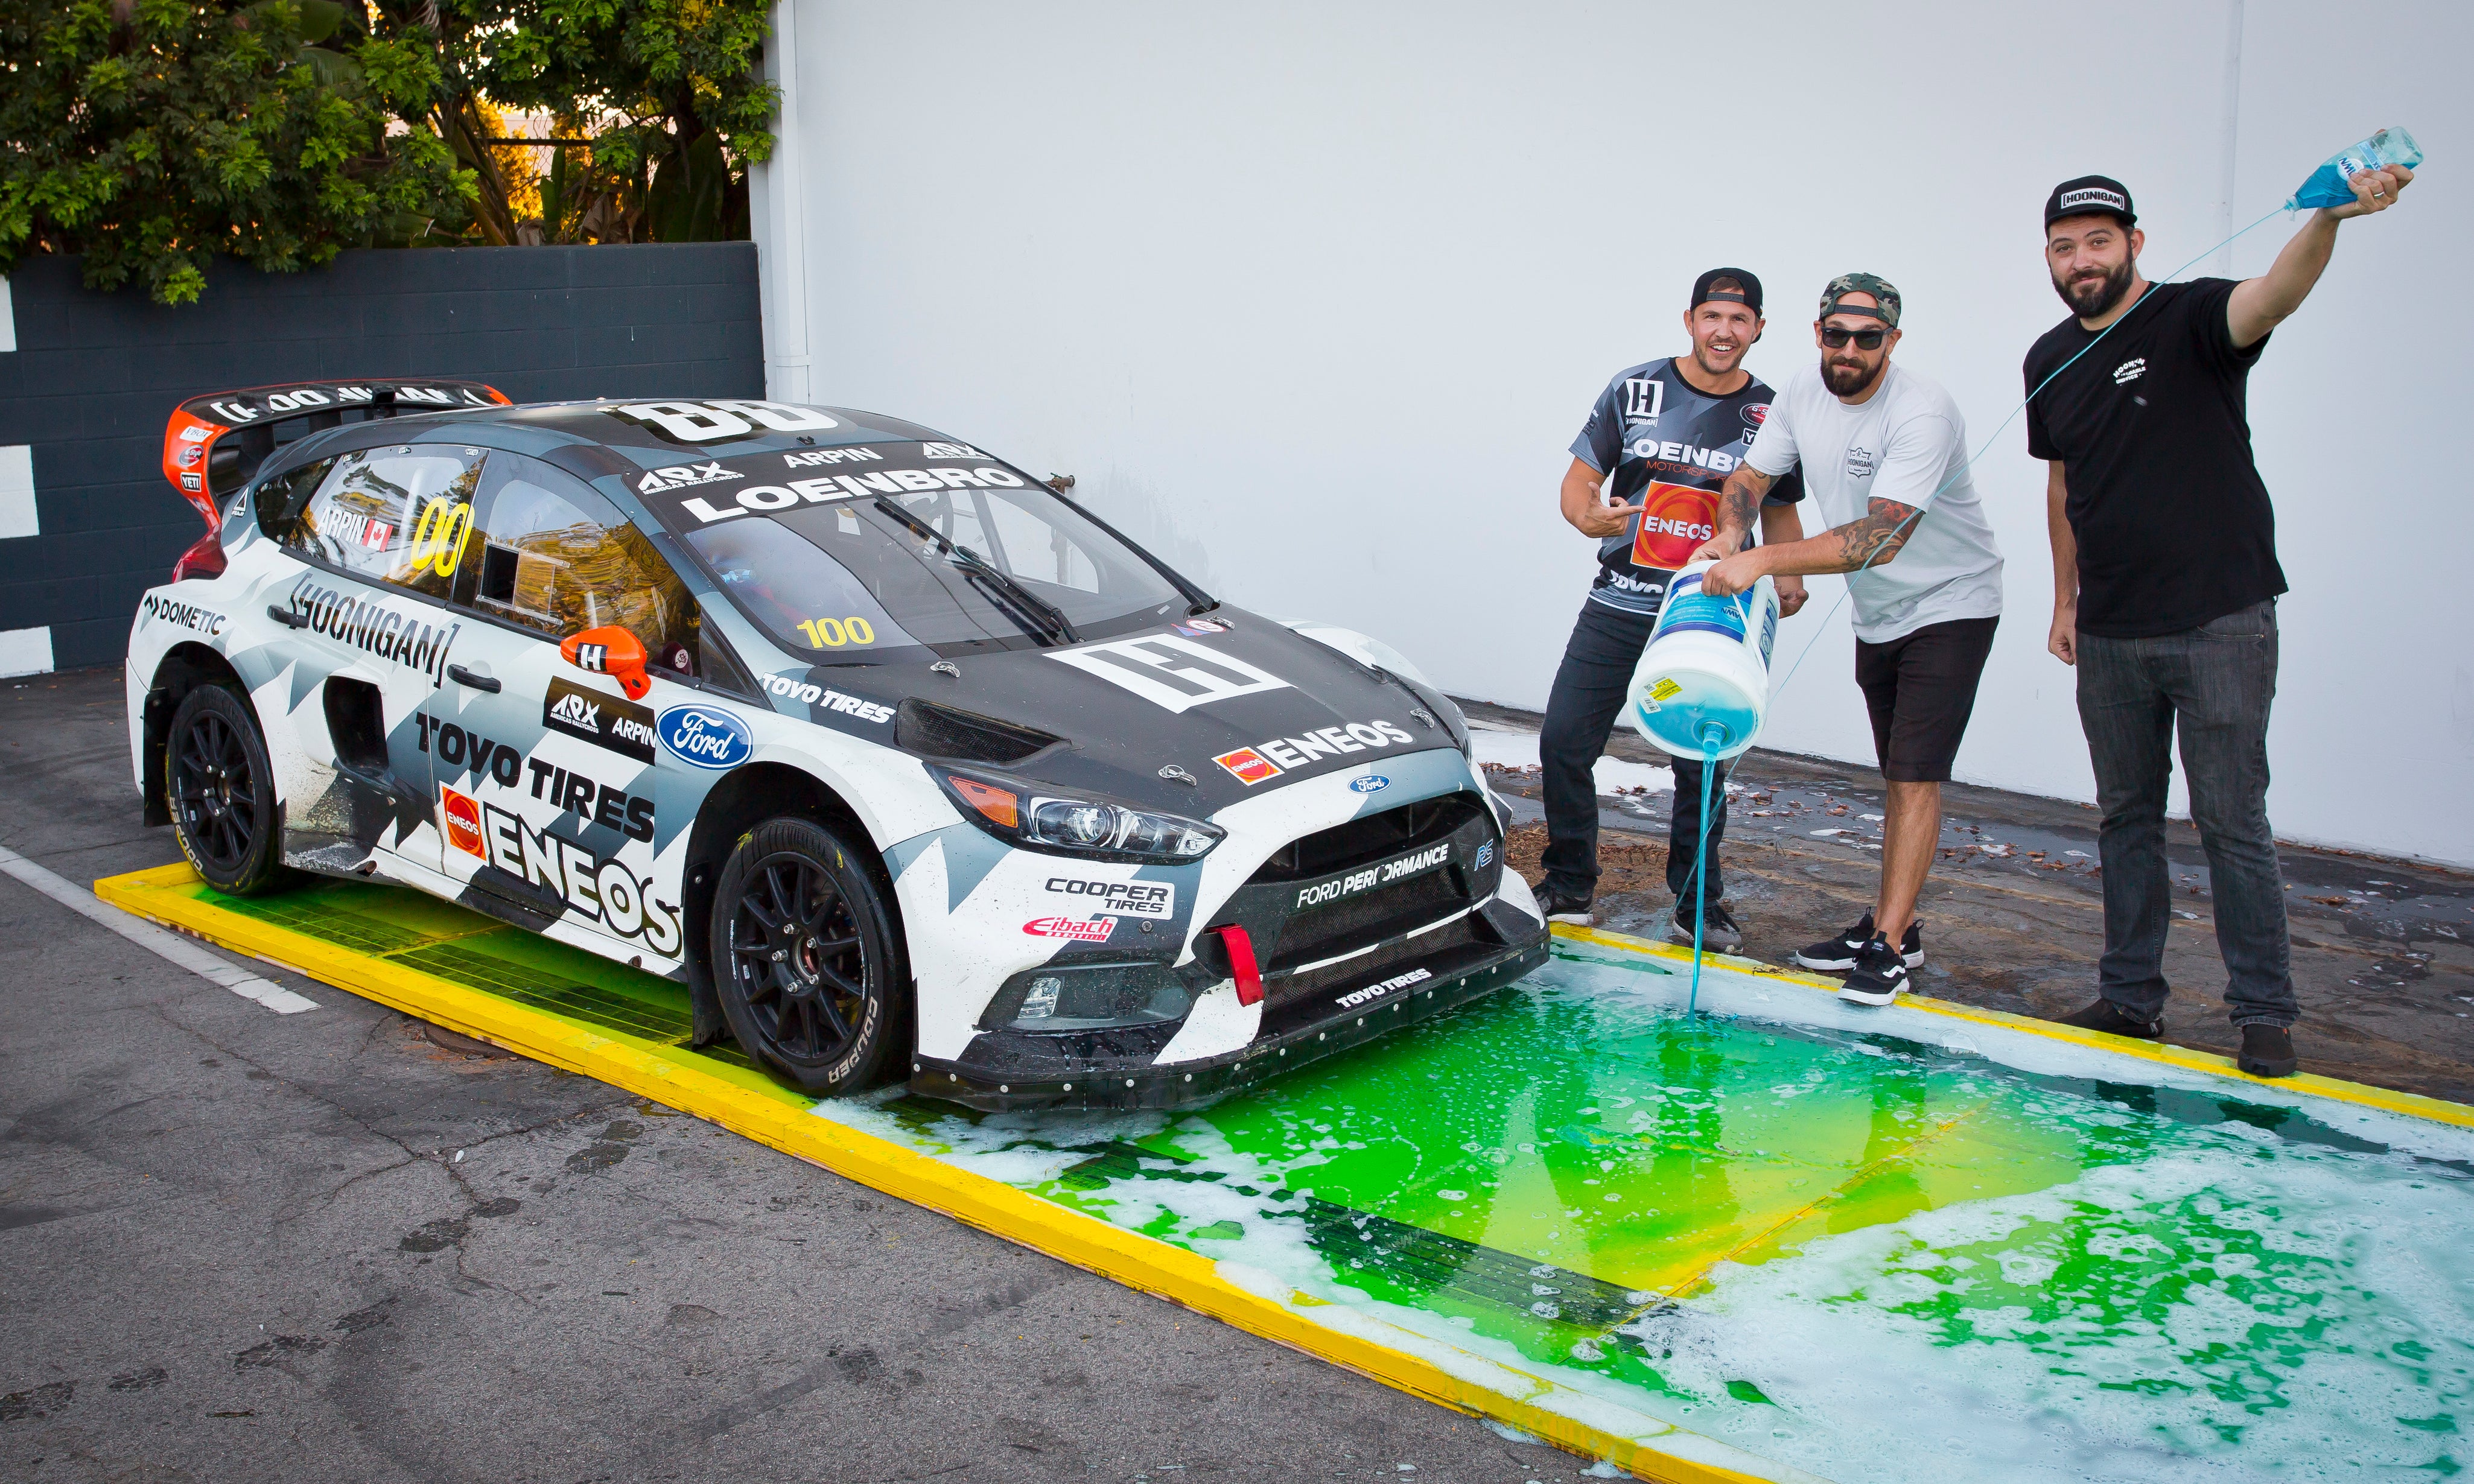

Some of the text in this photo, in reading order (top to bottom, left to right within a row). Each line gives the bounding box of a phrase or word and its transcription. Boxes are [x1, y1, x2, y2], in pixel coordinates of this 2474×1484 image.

[2063, 191, 2123, 209] [HOONIGAN]
[1632, 382, 1655, 413] H
[1752, 405, 1767, 415] G-S
[186, 427, 208, 437] VBOX
[783, 447, 884, 469] ARPIN
[182, 476, 199, 488] YETI
[685, 473, 745, 486] RALLYCROSS
[1646, 460, 1728, 482] MOTORSPOR
[681, 467, 1025, 523] LOENBRO
[315, 507, 368, 544] ARPIN
[410, 497, 475, 577] 00
[1644, 516, 1712, 541] ENEOS
[159, 598, 226, 636] DOMETIC
[1721, 607, 1741, 620] AWN
[797, 617, 875, 648] 100
[580, 644, 602, 670] H
[763, 673, 896, 723] TOYO TIRES
[550, 712, 599, 734] AMERICAS RALLYCROSS
[612, 717, 656, 748] ARPIN
[673, 712, 733, 760] Ford
[1256, 720, 1414, 769] ENEOS
[415, 711, 655, 843] TOYO TIRES
[1230, 758, 1264, 773] ENEOS
[1356, 776, 1385, 792] Ford
[447, 811, 480, 836] ENEOS
[1474, 839, 1493, 871] RS
[483, 801, 682, 958] ENEOS
[1045, 878, 1168, 902] COOPER
[1104, 898, 1164, 913] TIRES
[1297, 881, 1341, 908] FORD
[1022, 917, 1113, 936] Eibach
[1336, 968, 1431, 1008] TOYO TIRES
